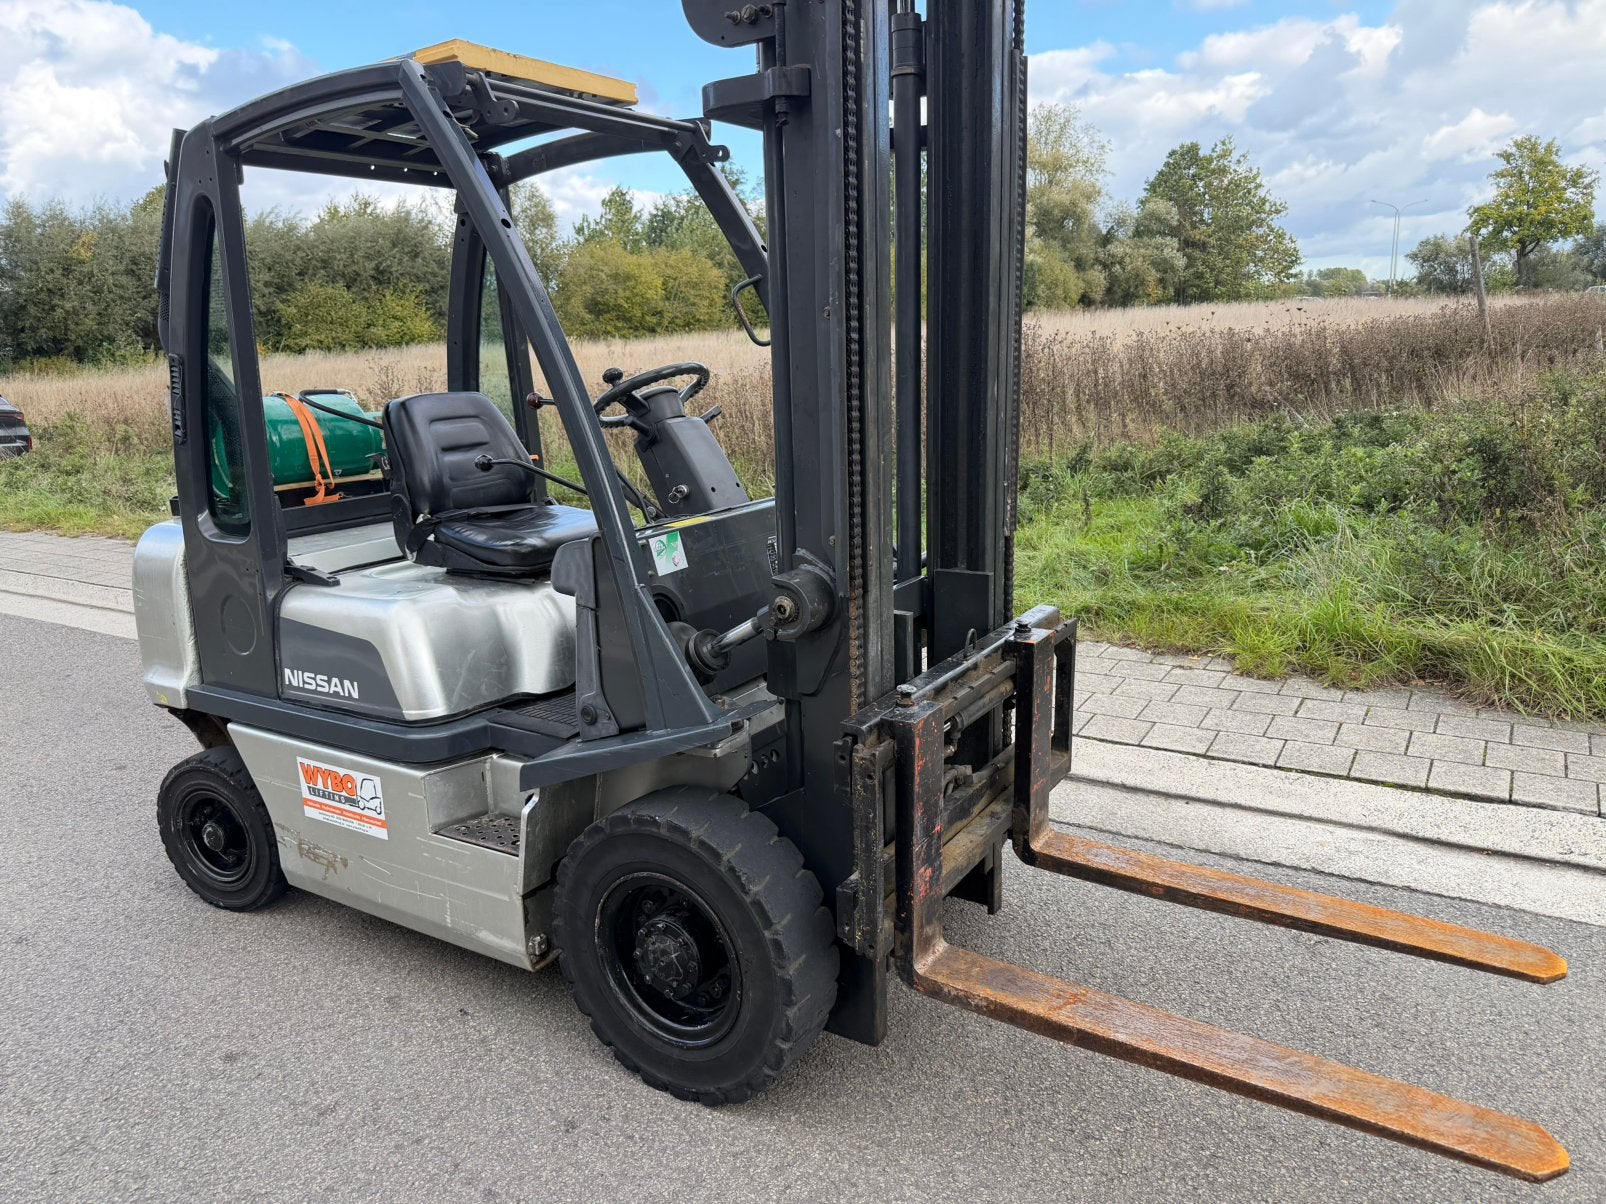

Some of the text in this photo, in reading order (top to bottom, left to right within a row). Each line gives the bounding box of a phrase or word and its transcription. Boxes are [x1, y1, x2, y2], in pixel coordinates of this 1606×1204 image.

[284, 667, 359, 699] NISSAN
[299, 761, 357, 797] WYBO
[310, 787, 346, 803] LIFTING
